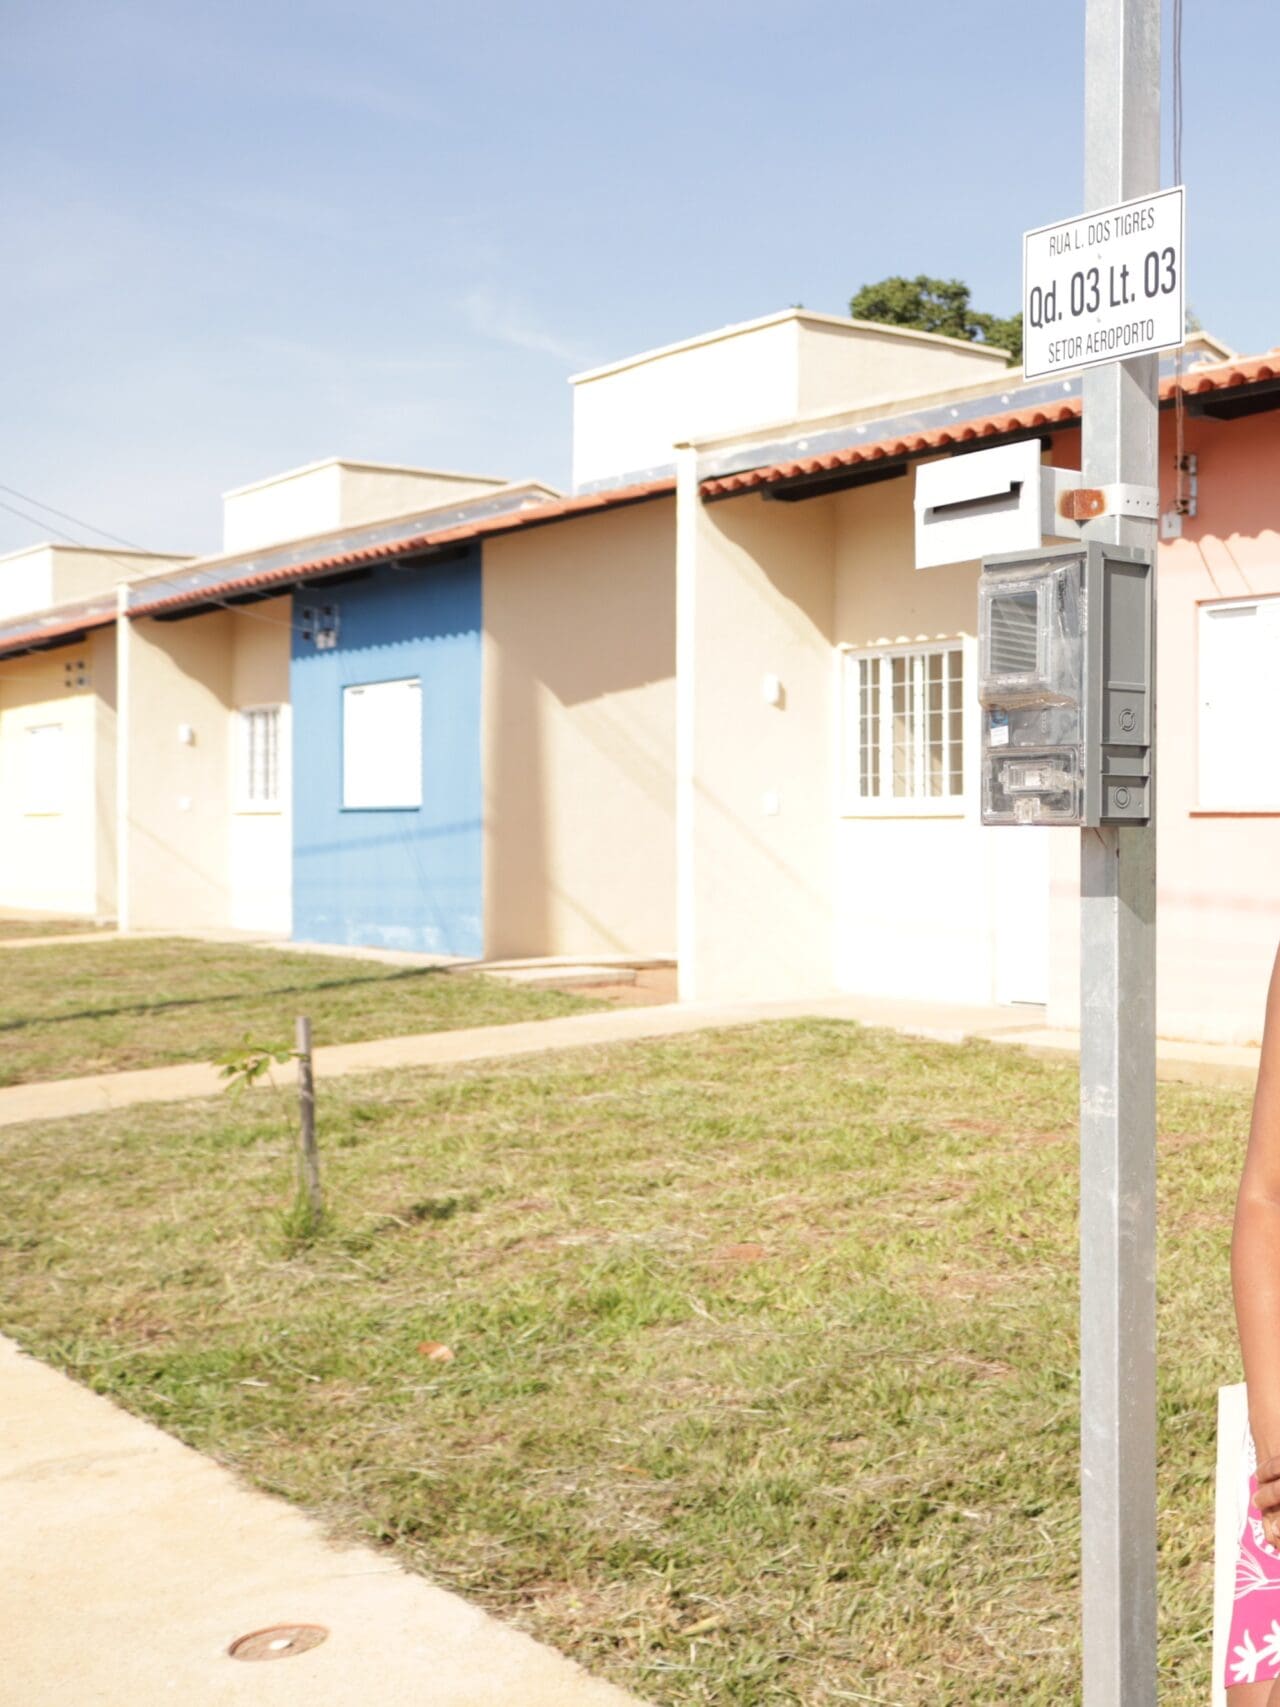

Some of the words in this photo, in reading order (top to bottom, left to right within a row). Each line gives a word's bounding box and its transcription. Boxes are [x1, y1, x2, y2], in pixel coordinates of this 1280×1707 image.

[1049, 232, 1071, 257] RUA
[1075, 229, 1084, 249] L.
[1089, 221, 1110, 246] DOS
[1114, 207, 1155, 237] TIGRES
[1030, 280, 1062, 329] Qd.
[1071, 267, 1100, 316] 03
[1110, 264, 1135, 307] Lt.
[1145, 247, 1176, 298] 03
[1049, 335, 1082, 363] SETOR
[1086, 319, 1154, 355] AEROPORTO
